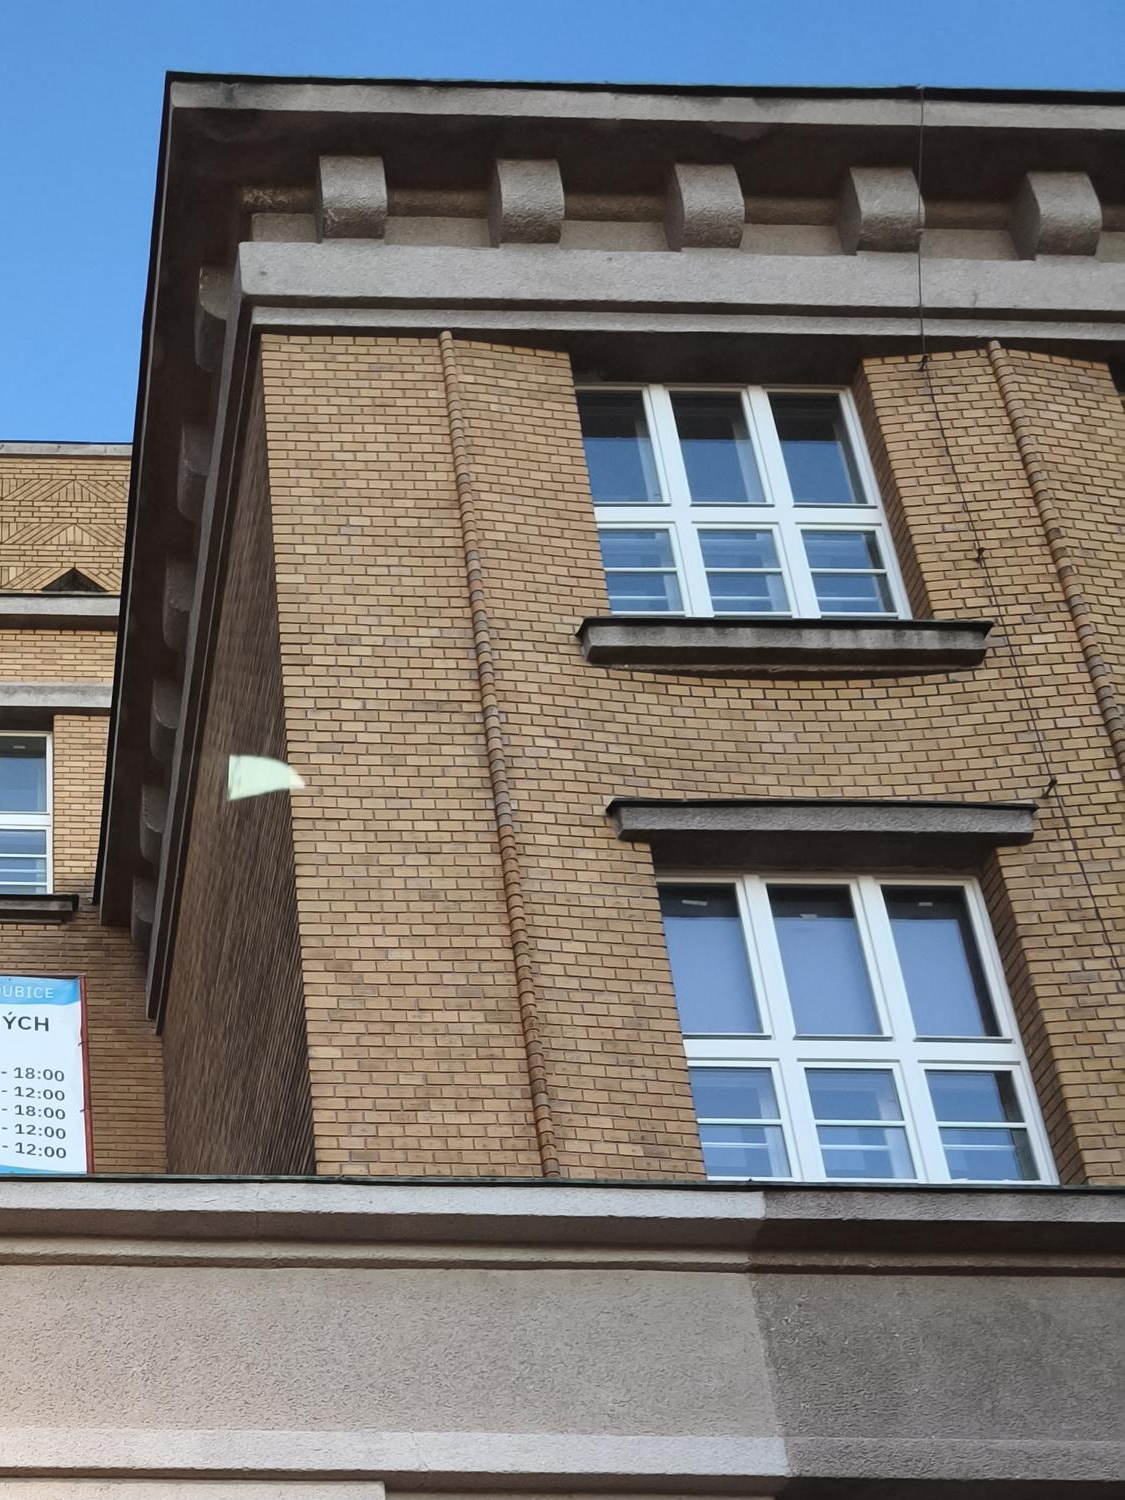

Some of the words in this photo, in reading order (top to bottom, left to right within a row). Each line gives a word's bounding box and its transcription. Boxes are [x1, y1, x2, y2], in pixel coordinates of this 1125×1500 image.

[14, 1067, 65, 1082] 18:00
[14, 1086, 65, 1101] 12:00
[15, 1105, 66, 1120] 18:00
[15, 1124, 66, 1139] 12:00
[15, 1143, 66, 1159] 12:00
